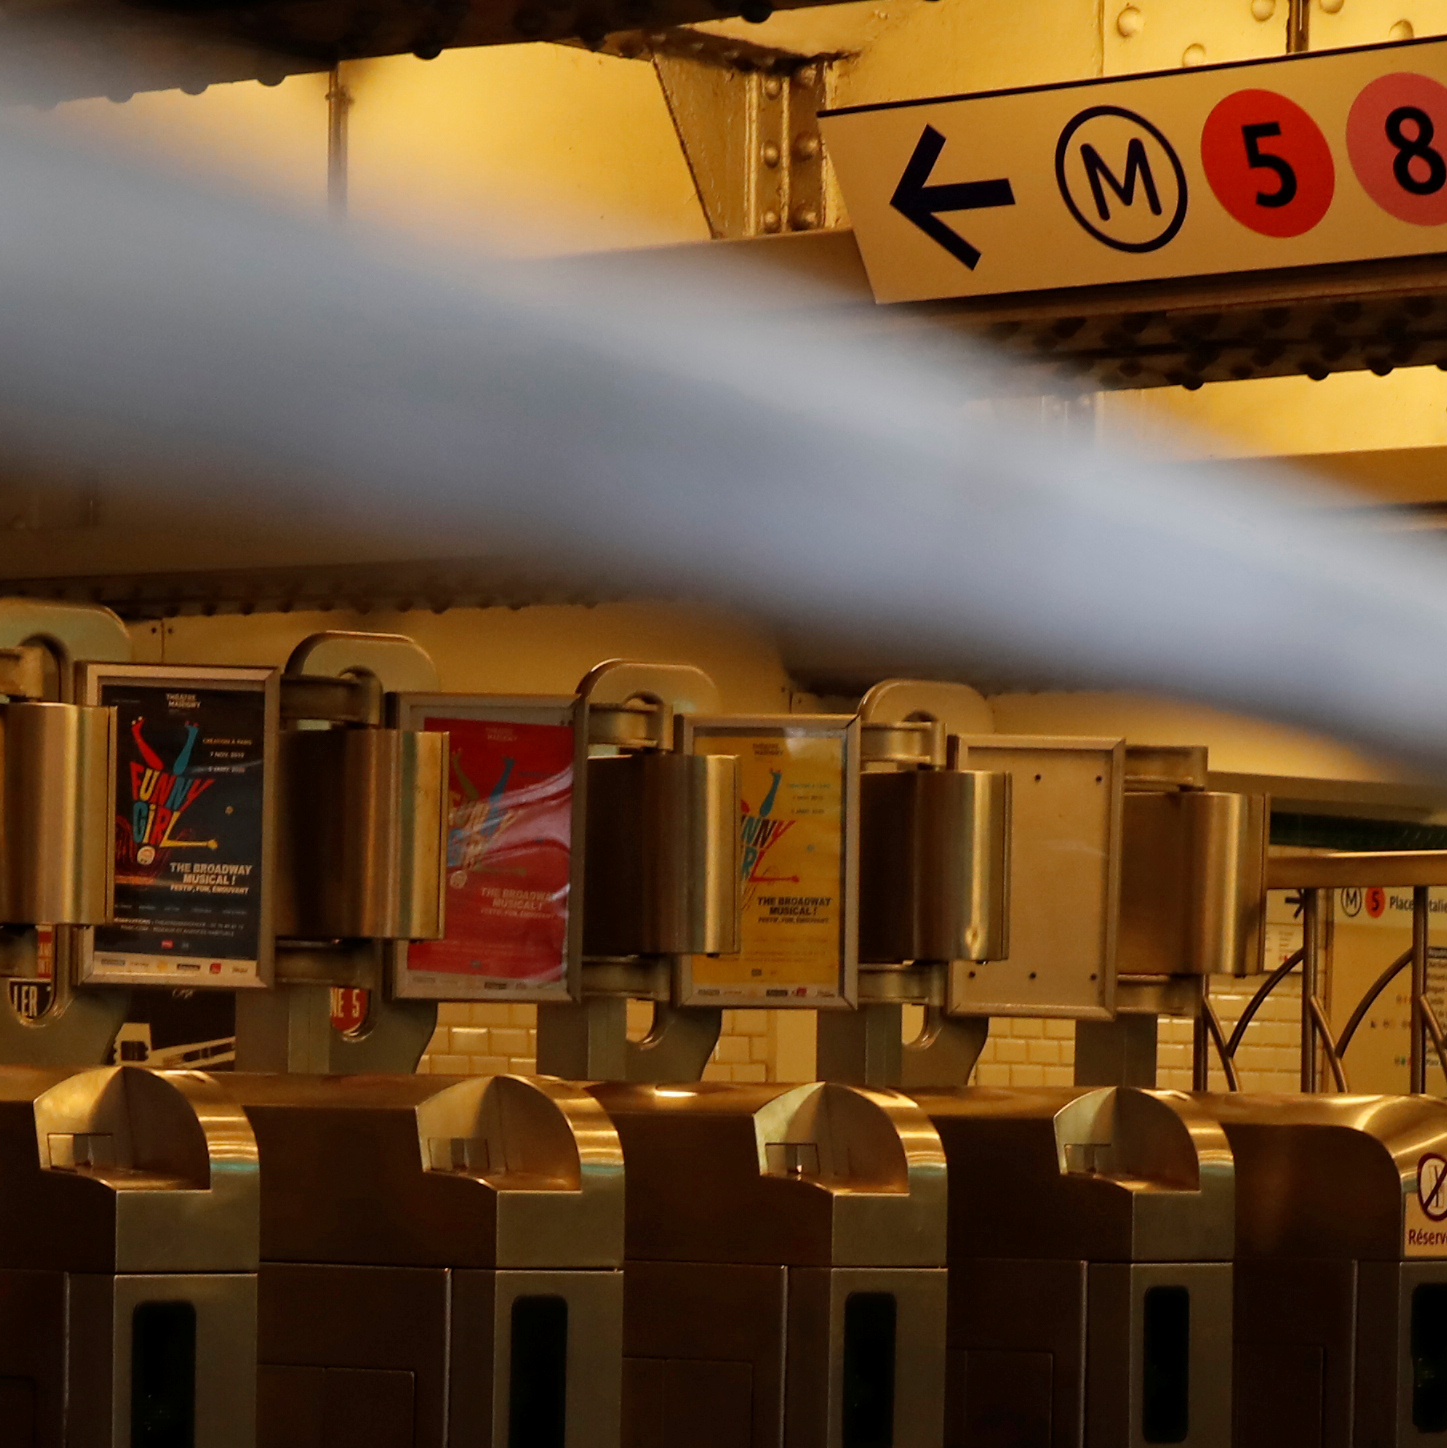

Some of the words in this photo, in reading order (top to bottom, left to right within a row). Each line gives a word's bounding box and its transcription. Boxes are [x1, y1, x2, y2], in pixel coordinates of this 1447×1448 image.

[1241, 121, 1297, 209] 5
[1384, 105, 1447, 196] 8
[130, 761, 215, 813] FUNNY
[170, 861, 192, 873] THE
[193, 862, 252, 876] BROADWAY
[183, 873, 230, 885] MUSICAL
[502, 888, 554, 901] BROADWA
[757, 896, 776, 906] THE
[778, 896, 831, 907] BROADWAY
[1371, 891, 1380, 912] 5
[1389, 896, 1414, 912] Place
[769, 906, 811, 916] MUSICAL
